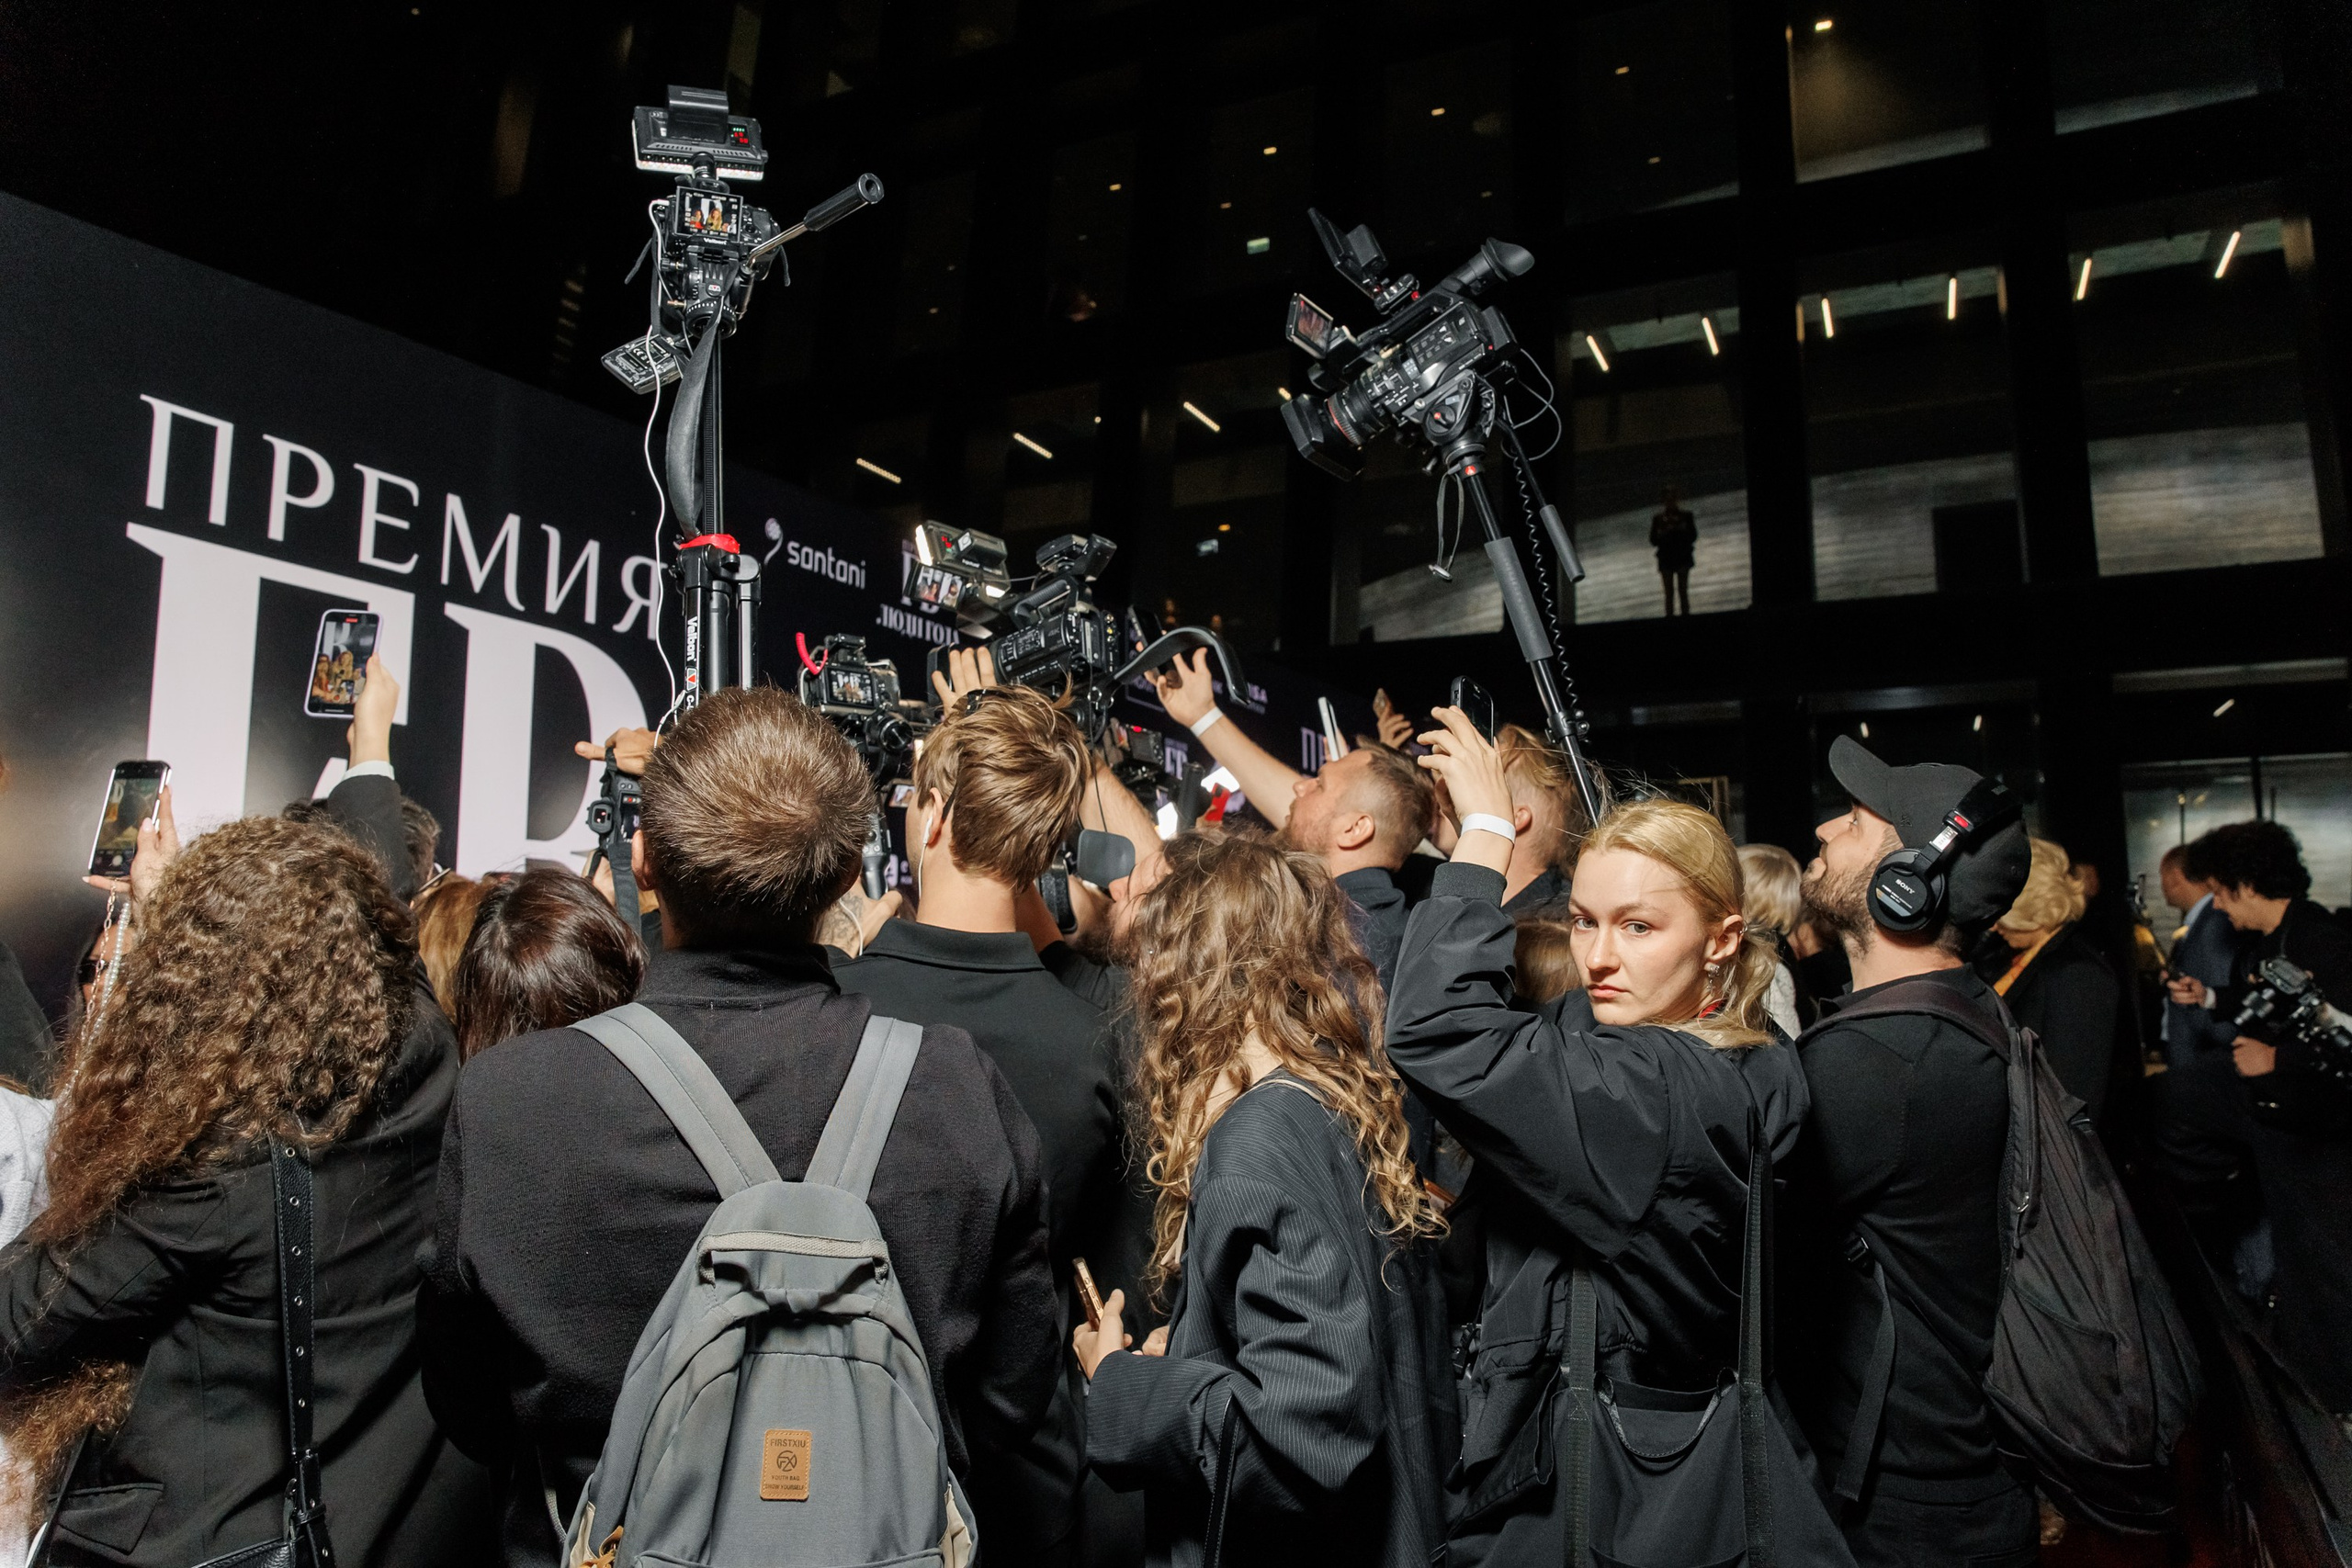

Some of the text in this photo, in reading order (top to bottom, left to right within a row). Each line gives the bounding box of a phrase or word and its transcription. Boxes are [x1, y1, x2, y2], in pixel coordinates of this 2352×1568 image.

[140, 393, 669, 640] ПРЕМИЯ
[787, 540, 866, 589] santani
[686, 616, 697, 661] Velbon
[1895, 878, 1915, 894] SONY
[770, 1438, 807, 1448] FIRSTXIU
